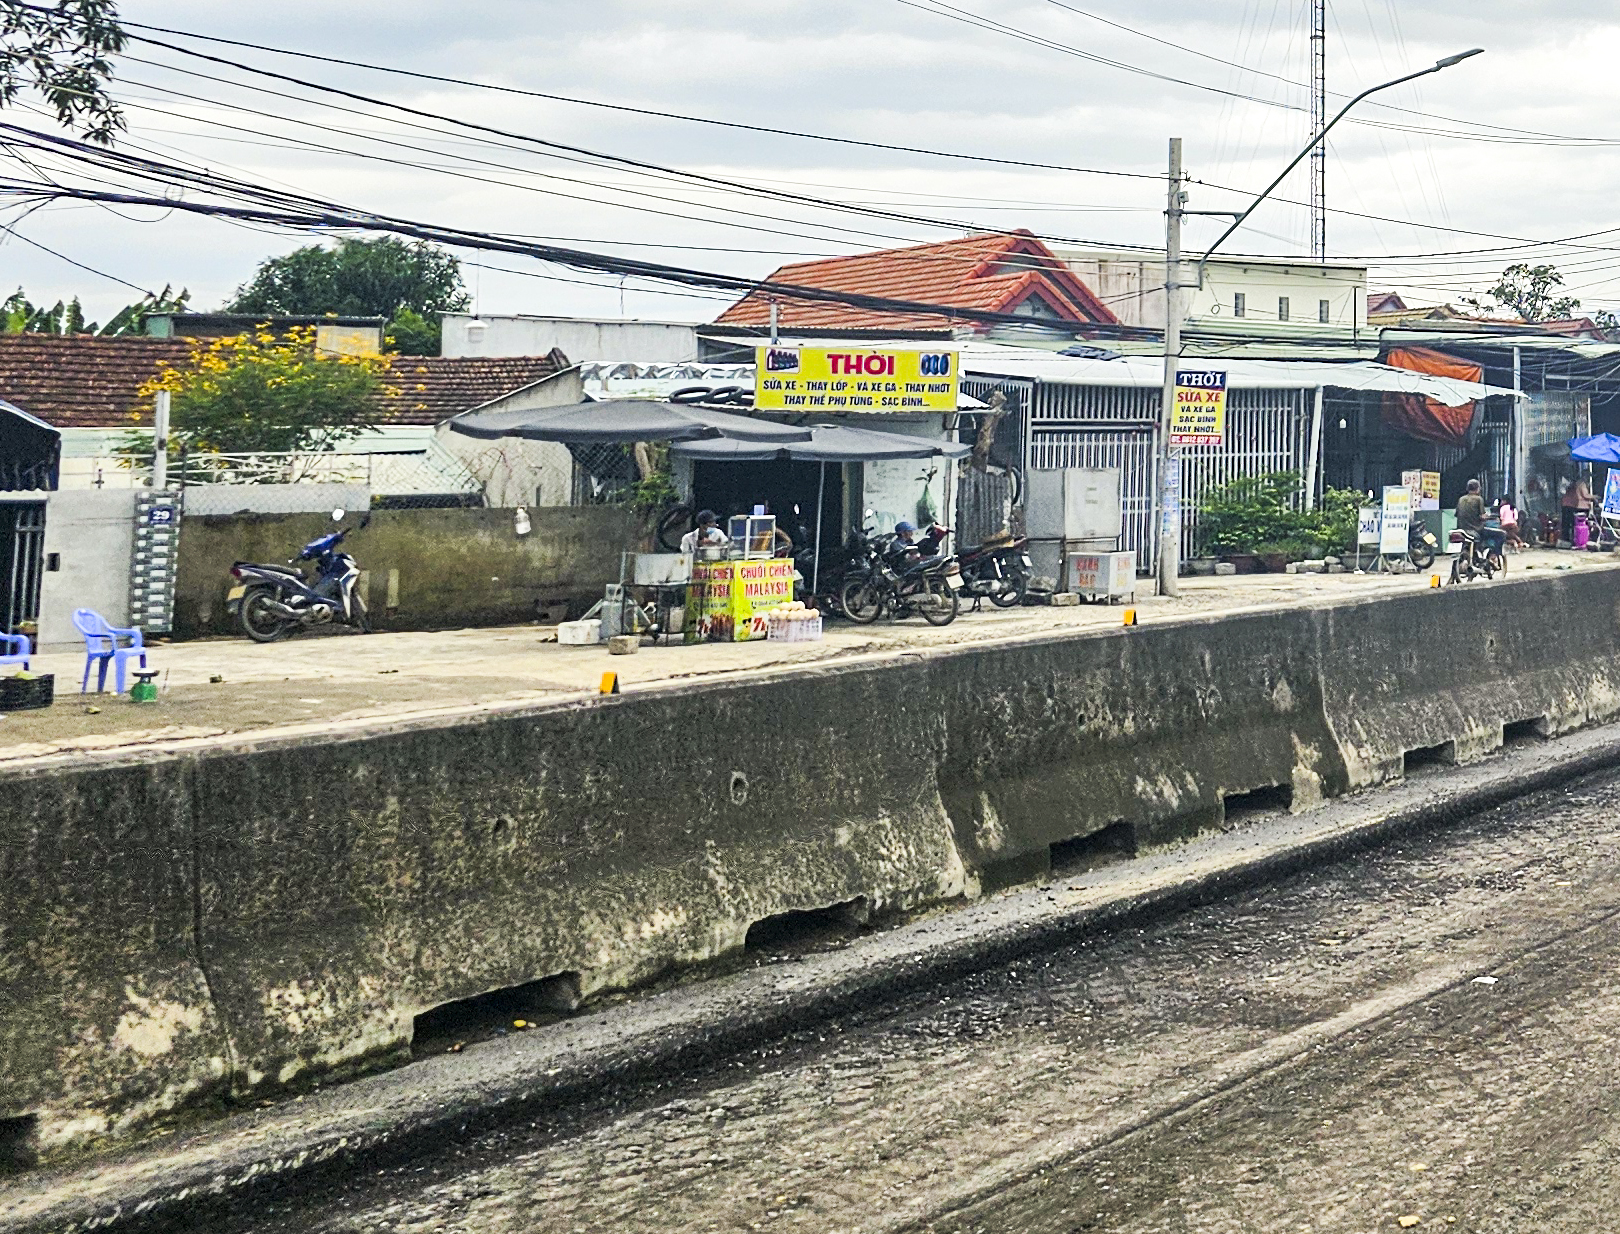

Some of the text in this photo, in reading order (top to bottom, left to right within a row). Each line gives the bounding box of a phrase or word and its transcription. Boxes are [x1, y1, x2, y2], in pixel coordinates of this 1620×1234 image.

[827, 350, 895, 375] THỜI
[763, 377, 782, 390] SỬA
[785, 380, 797, 390] XE
[806, 381, 828, 391] THAY
[871, 382, 882, 392] XE
[885, 382, 897, 392] GA
[905, 383, 926, 393] THAY
[784, 395, 806, 405] THAY
[1206, 392, 1221, 403] XE
[745, 581, 789, 597] MALAYSIA
